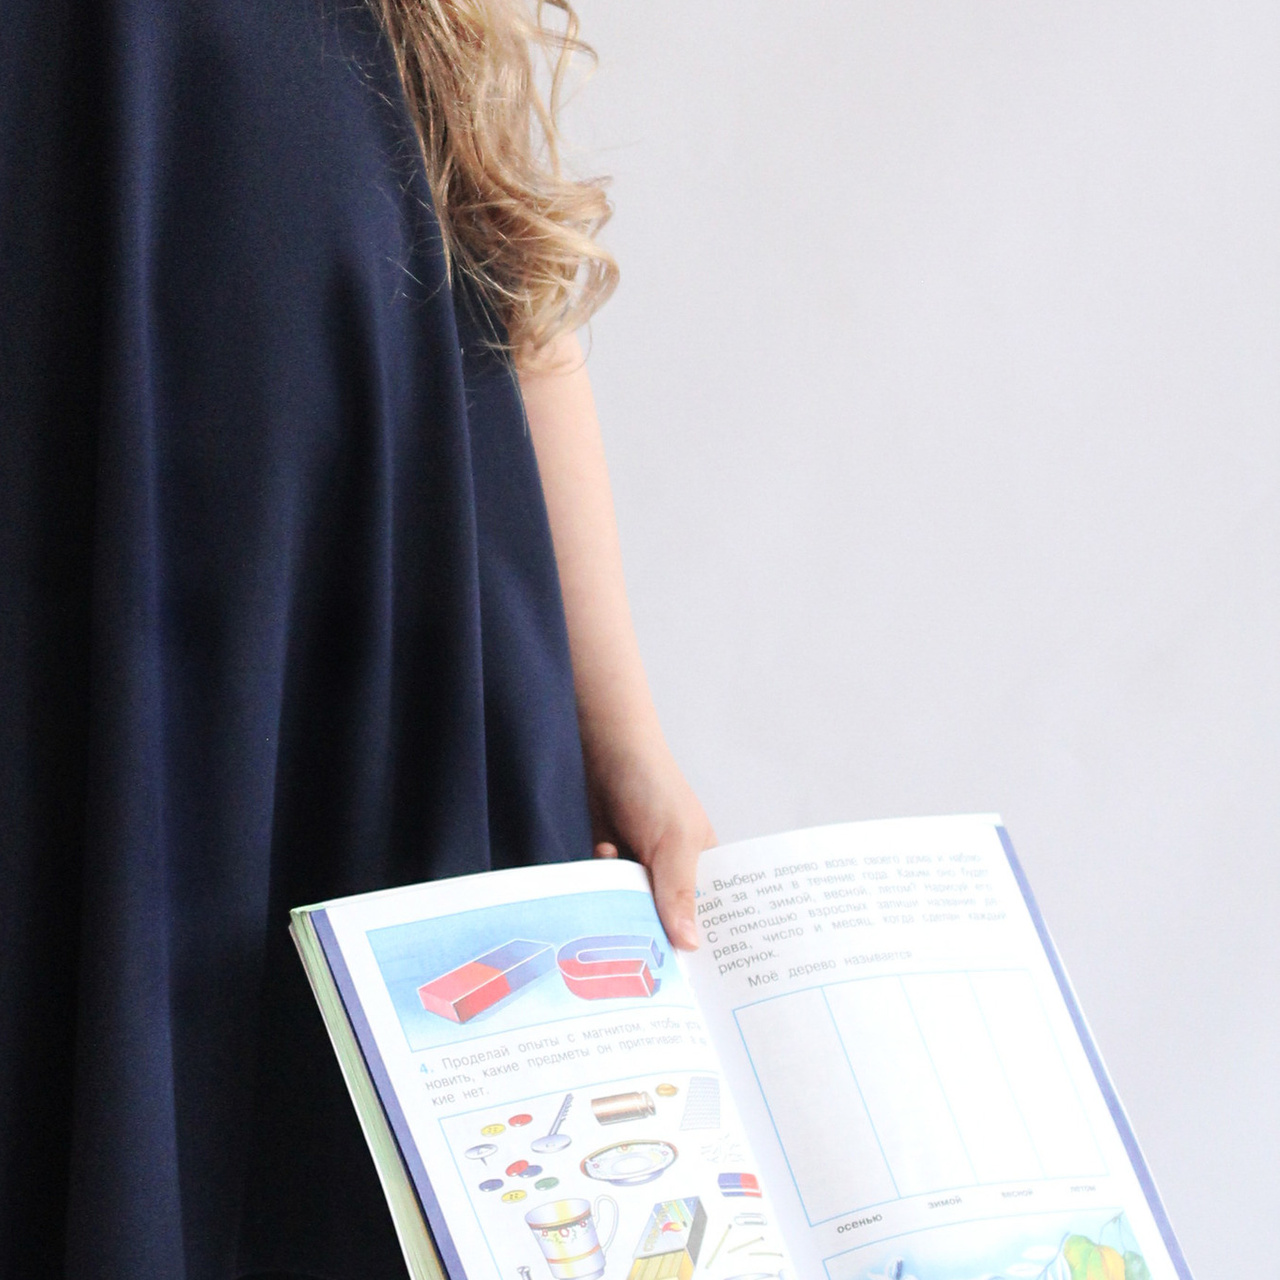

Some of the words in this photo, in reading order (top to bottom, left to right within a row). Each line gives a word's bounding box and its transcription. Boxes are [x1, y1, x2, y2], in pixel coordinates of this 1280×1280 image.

[713, 870, 766, 893] Выбери
[774, 861, 819, 879] дерево
[697, 898, 723, 915] дай
[756, 883, 784, 897] ним
[730, 910, 798, 937] помощью
[808, 901, 868, 919] взрослых
[763, 926, 805, 944] число
[718, 950, 780, 977] рисунок.
[747, 971, 780, 988] Моё
[788, 959, 837, 980] дерево
[844, 950, 914, 967] называется
[443, 1045, 510, 1070] Проделай
[518, 1035, 560, 1055] опыты
[482, 1061, 520, 1078] какие
[527, 1048, 590, 1070] предметы
[431, 1093, 456, 1107] кие
[837, 1213, 883, 1234] осенью
[928, 1195, 962, 1210] зимой
